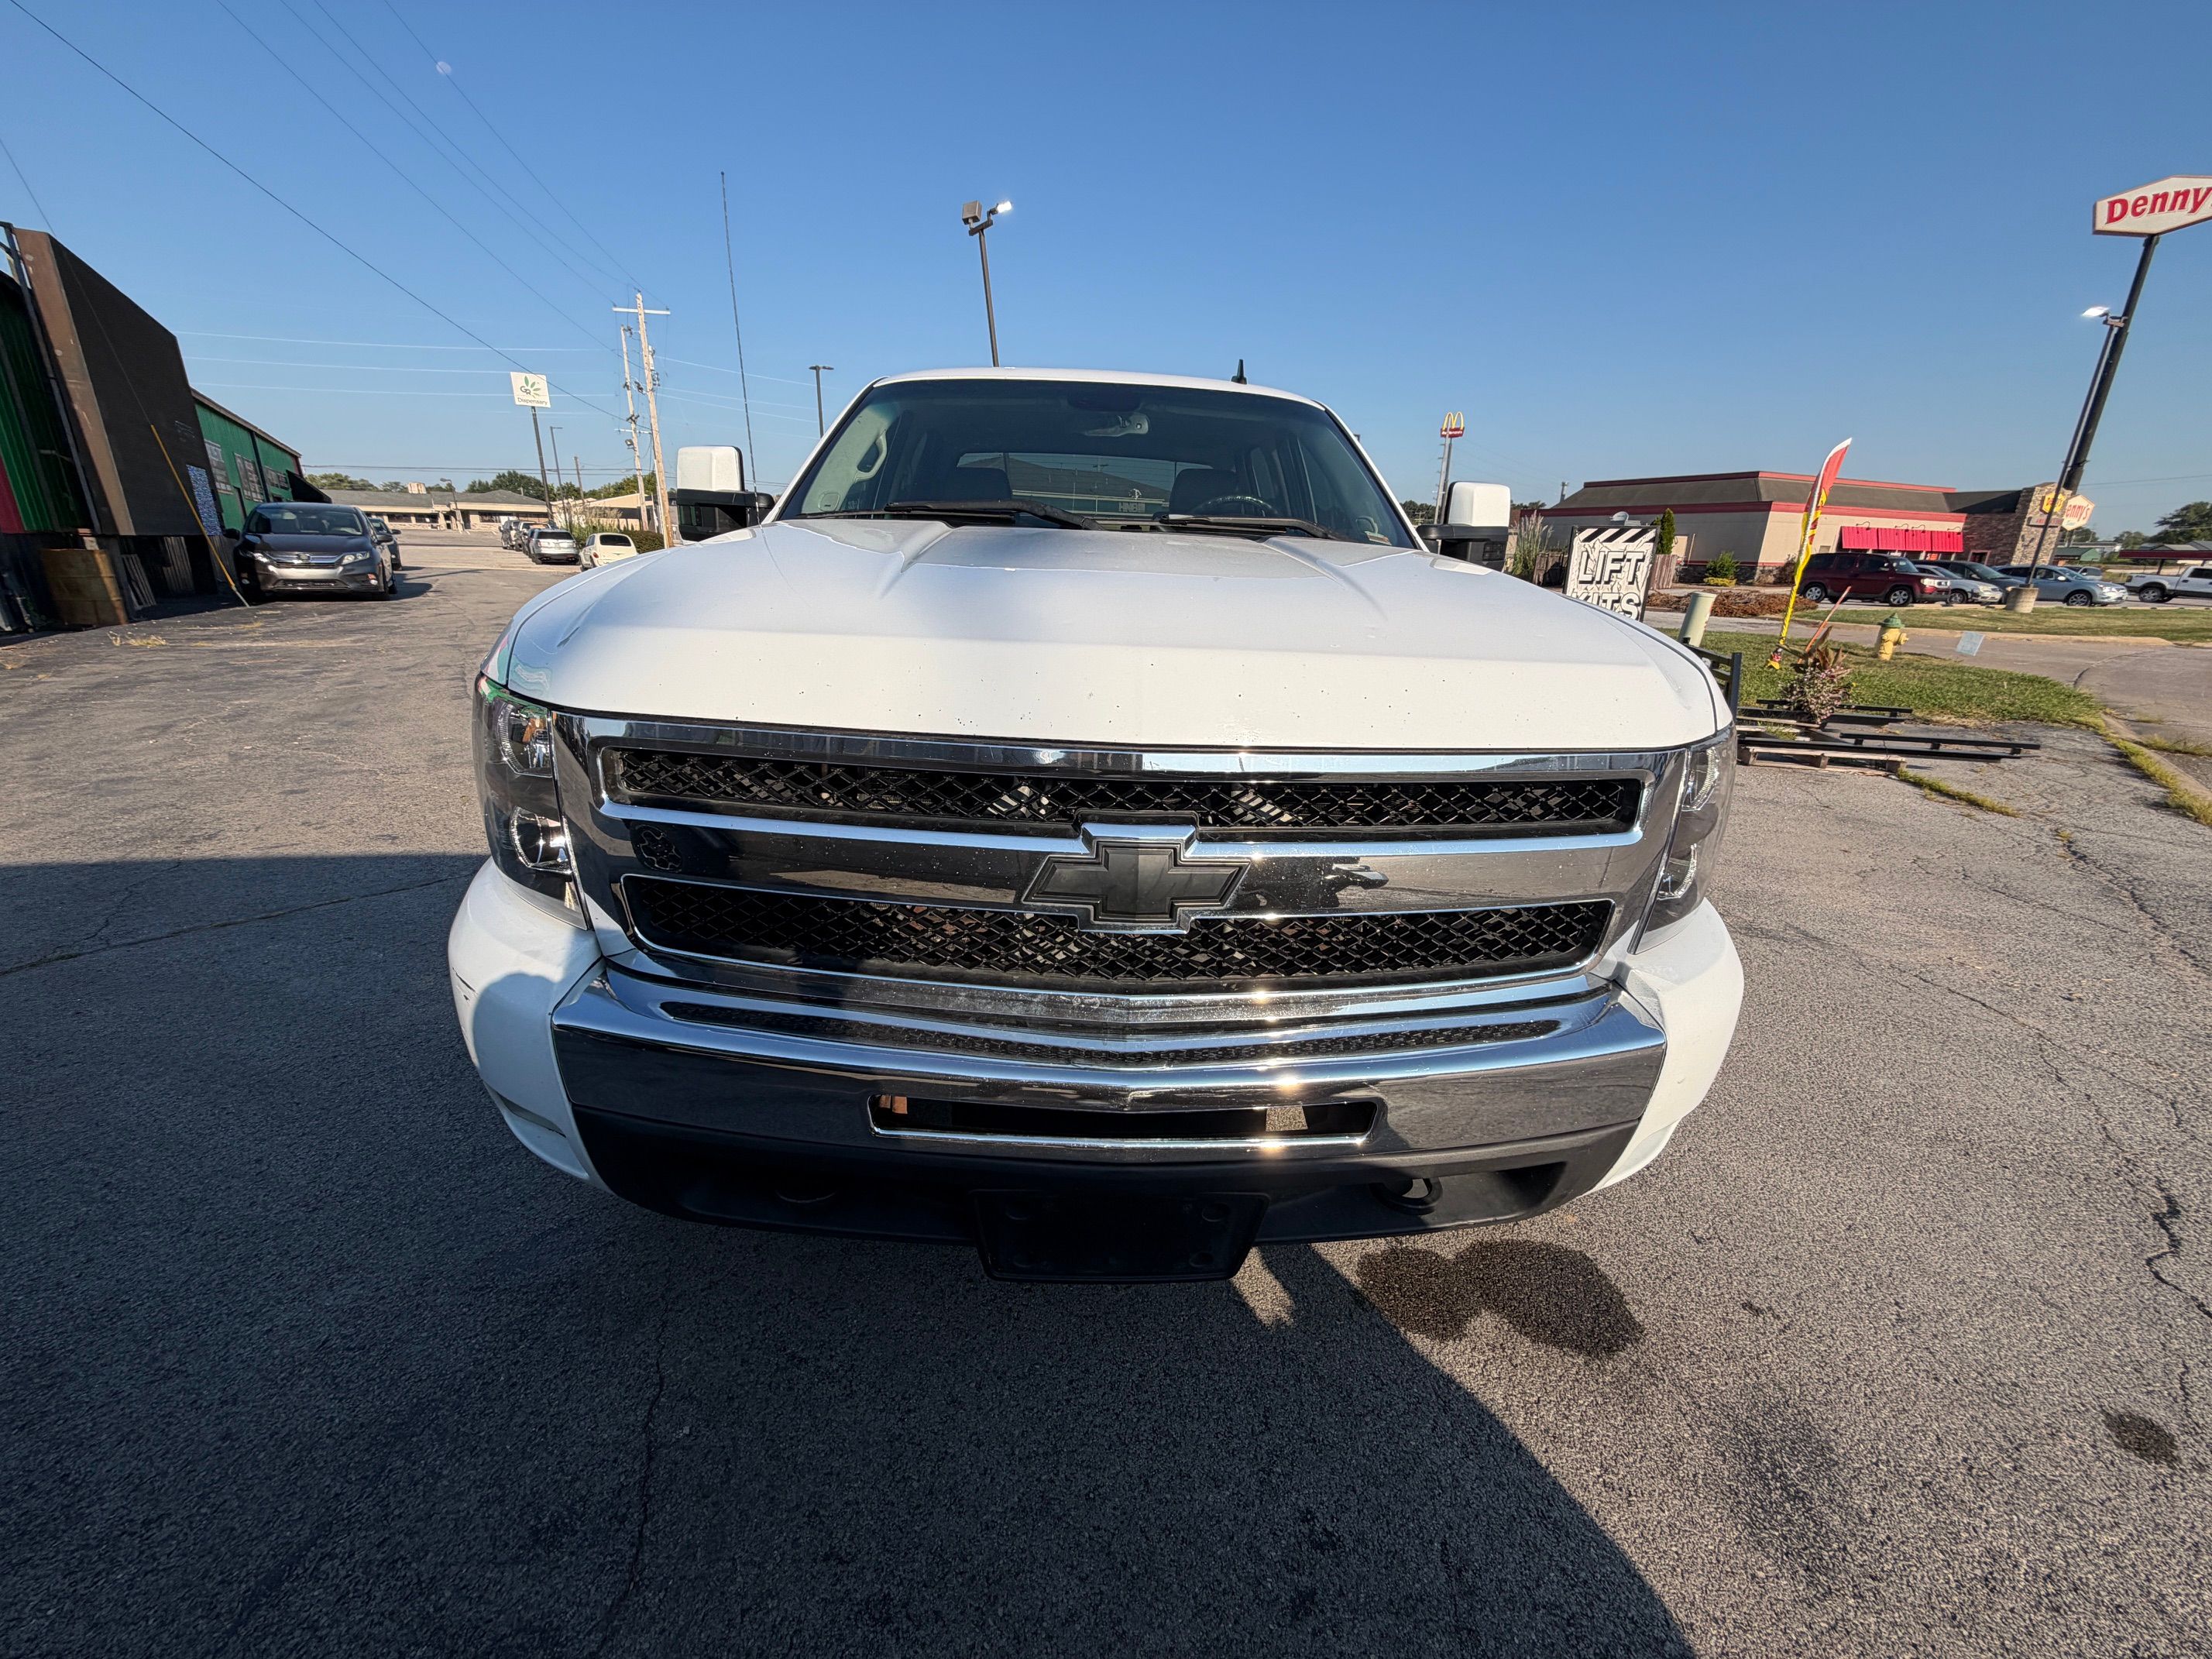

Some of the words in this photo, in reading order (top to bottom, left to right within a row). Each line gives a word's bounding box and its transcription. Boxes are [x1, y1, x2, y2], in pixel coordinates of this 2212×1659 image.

[2105, 186, 2212, 225] Denny
[2065, 504, 2090, 522] enny's
[1578, 551, 1645, 586] LIFT
